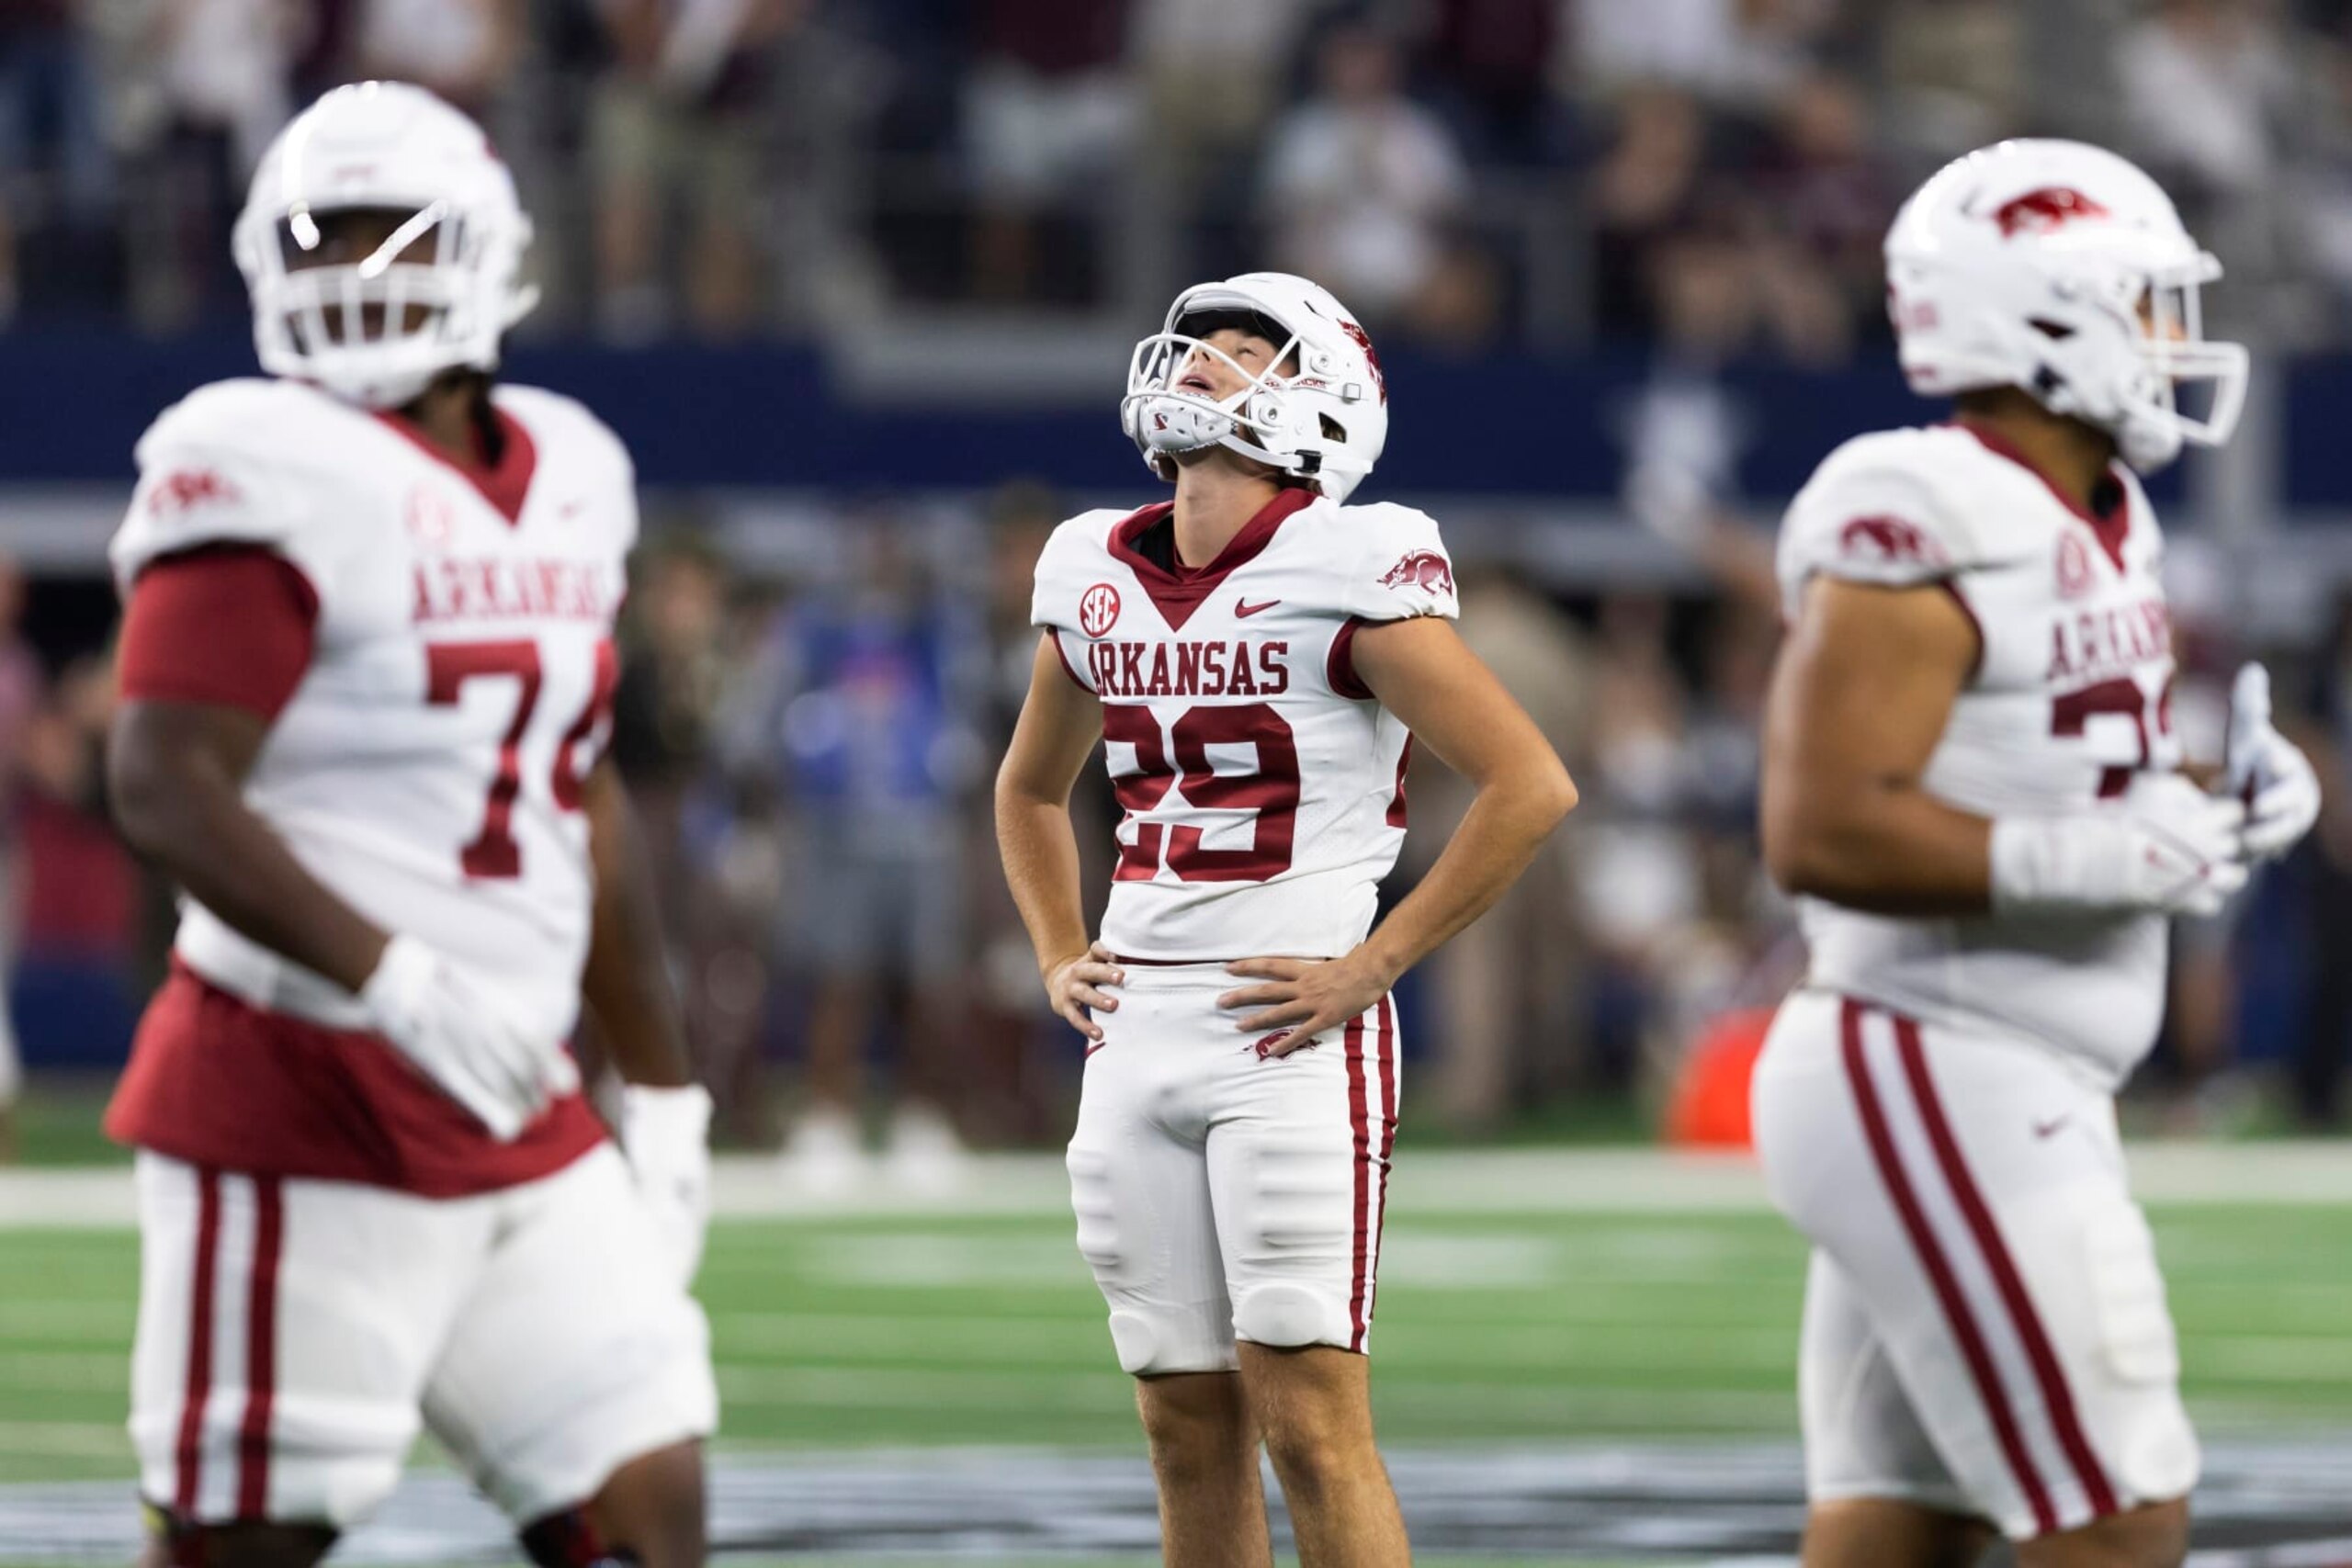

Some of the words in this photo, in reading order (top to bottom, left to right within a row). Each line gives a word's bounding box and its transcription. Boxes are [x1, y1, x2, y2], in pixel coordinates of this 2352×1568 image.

[1082, 587, 1118, 635] SEC
[1088, 641, 1288, 696] ARKANSAS
[1103, 703, 1300, 882] 29
